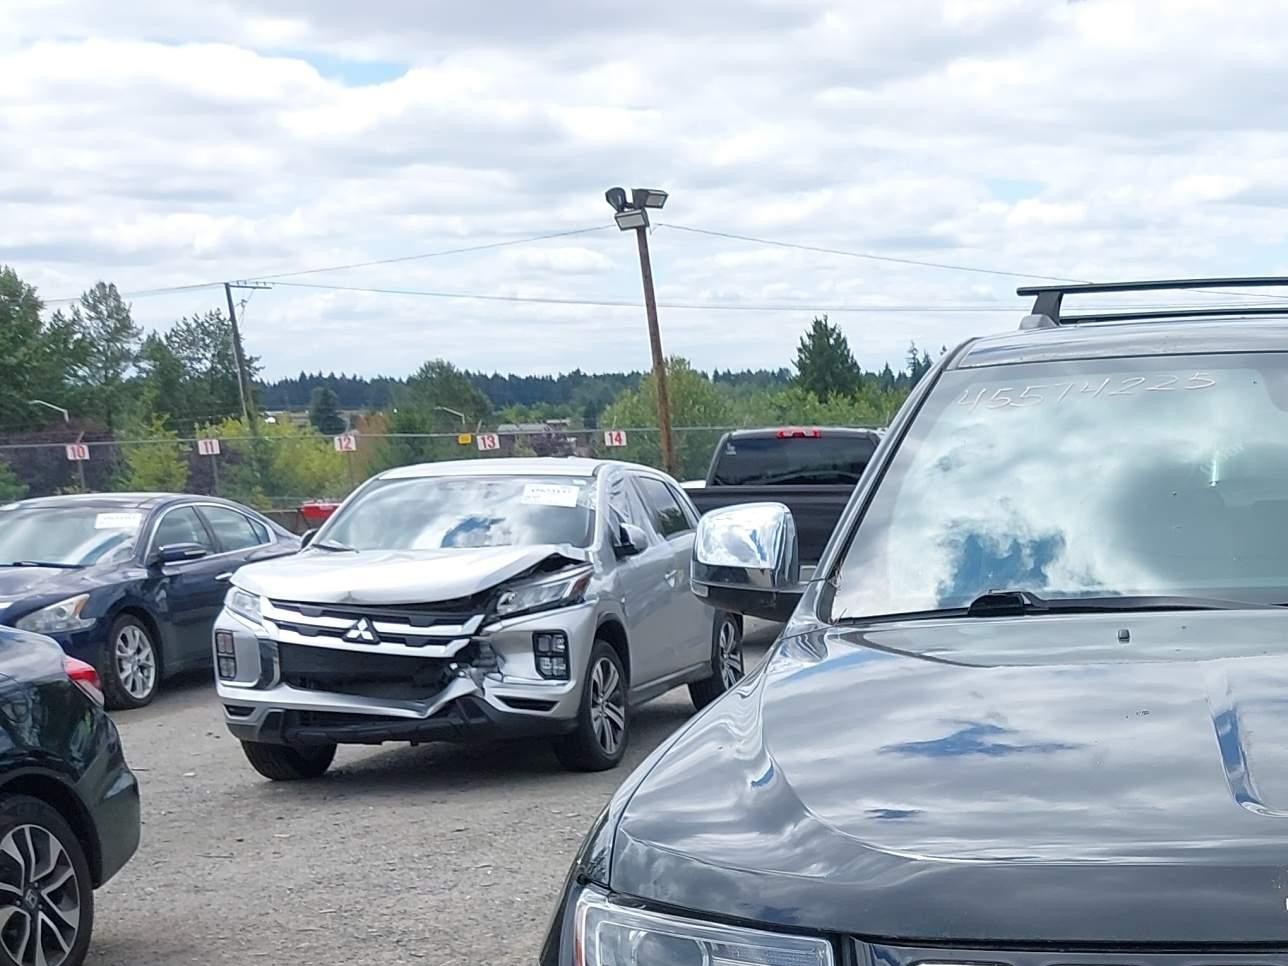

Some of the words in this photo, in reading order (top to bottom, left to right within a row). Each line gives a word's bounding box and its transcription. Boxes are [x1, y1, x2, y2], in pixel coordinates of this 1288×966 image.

[338, 436, 352, 450] 12
[480, 434, 496, 449] 13
[608, 432, 623, 445] 14
[71, 446, 85, 458] 10
